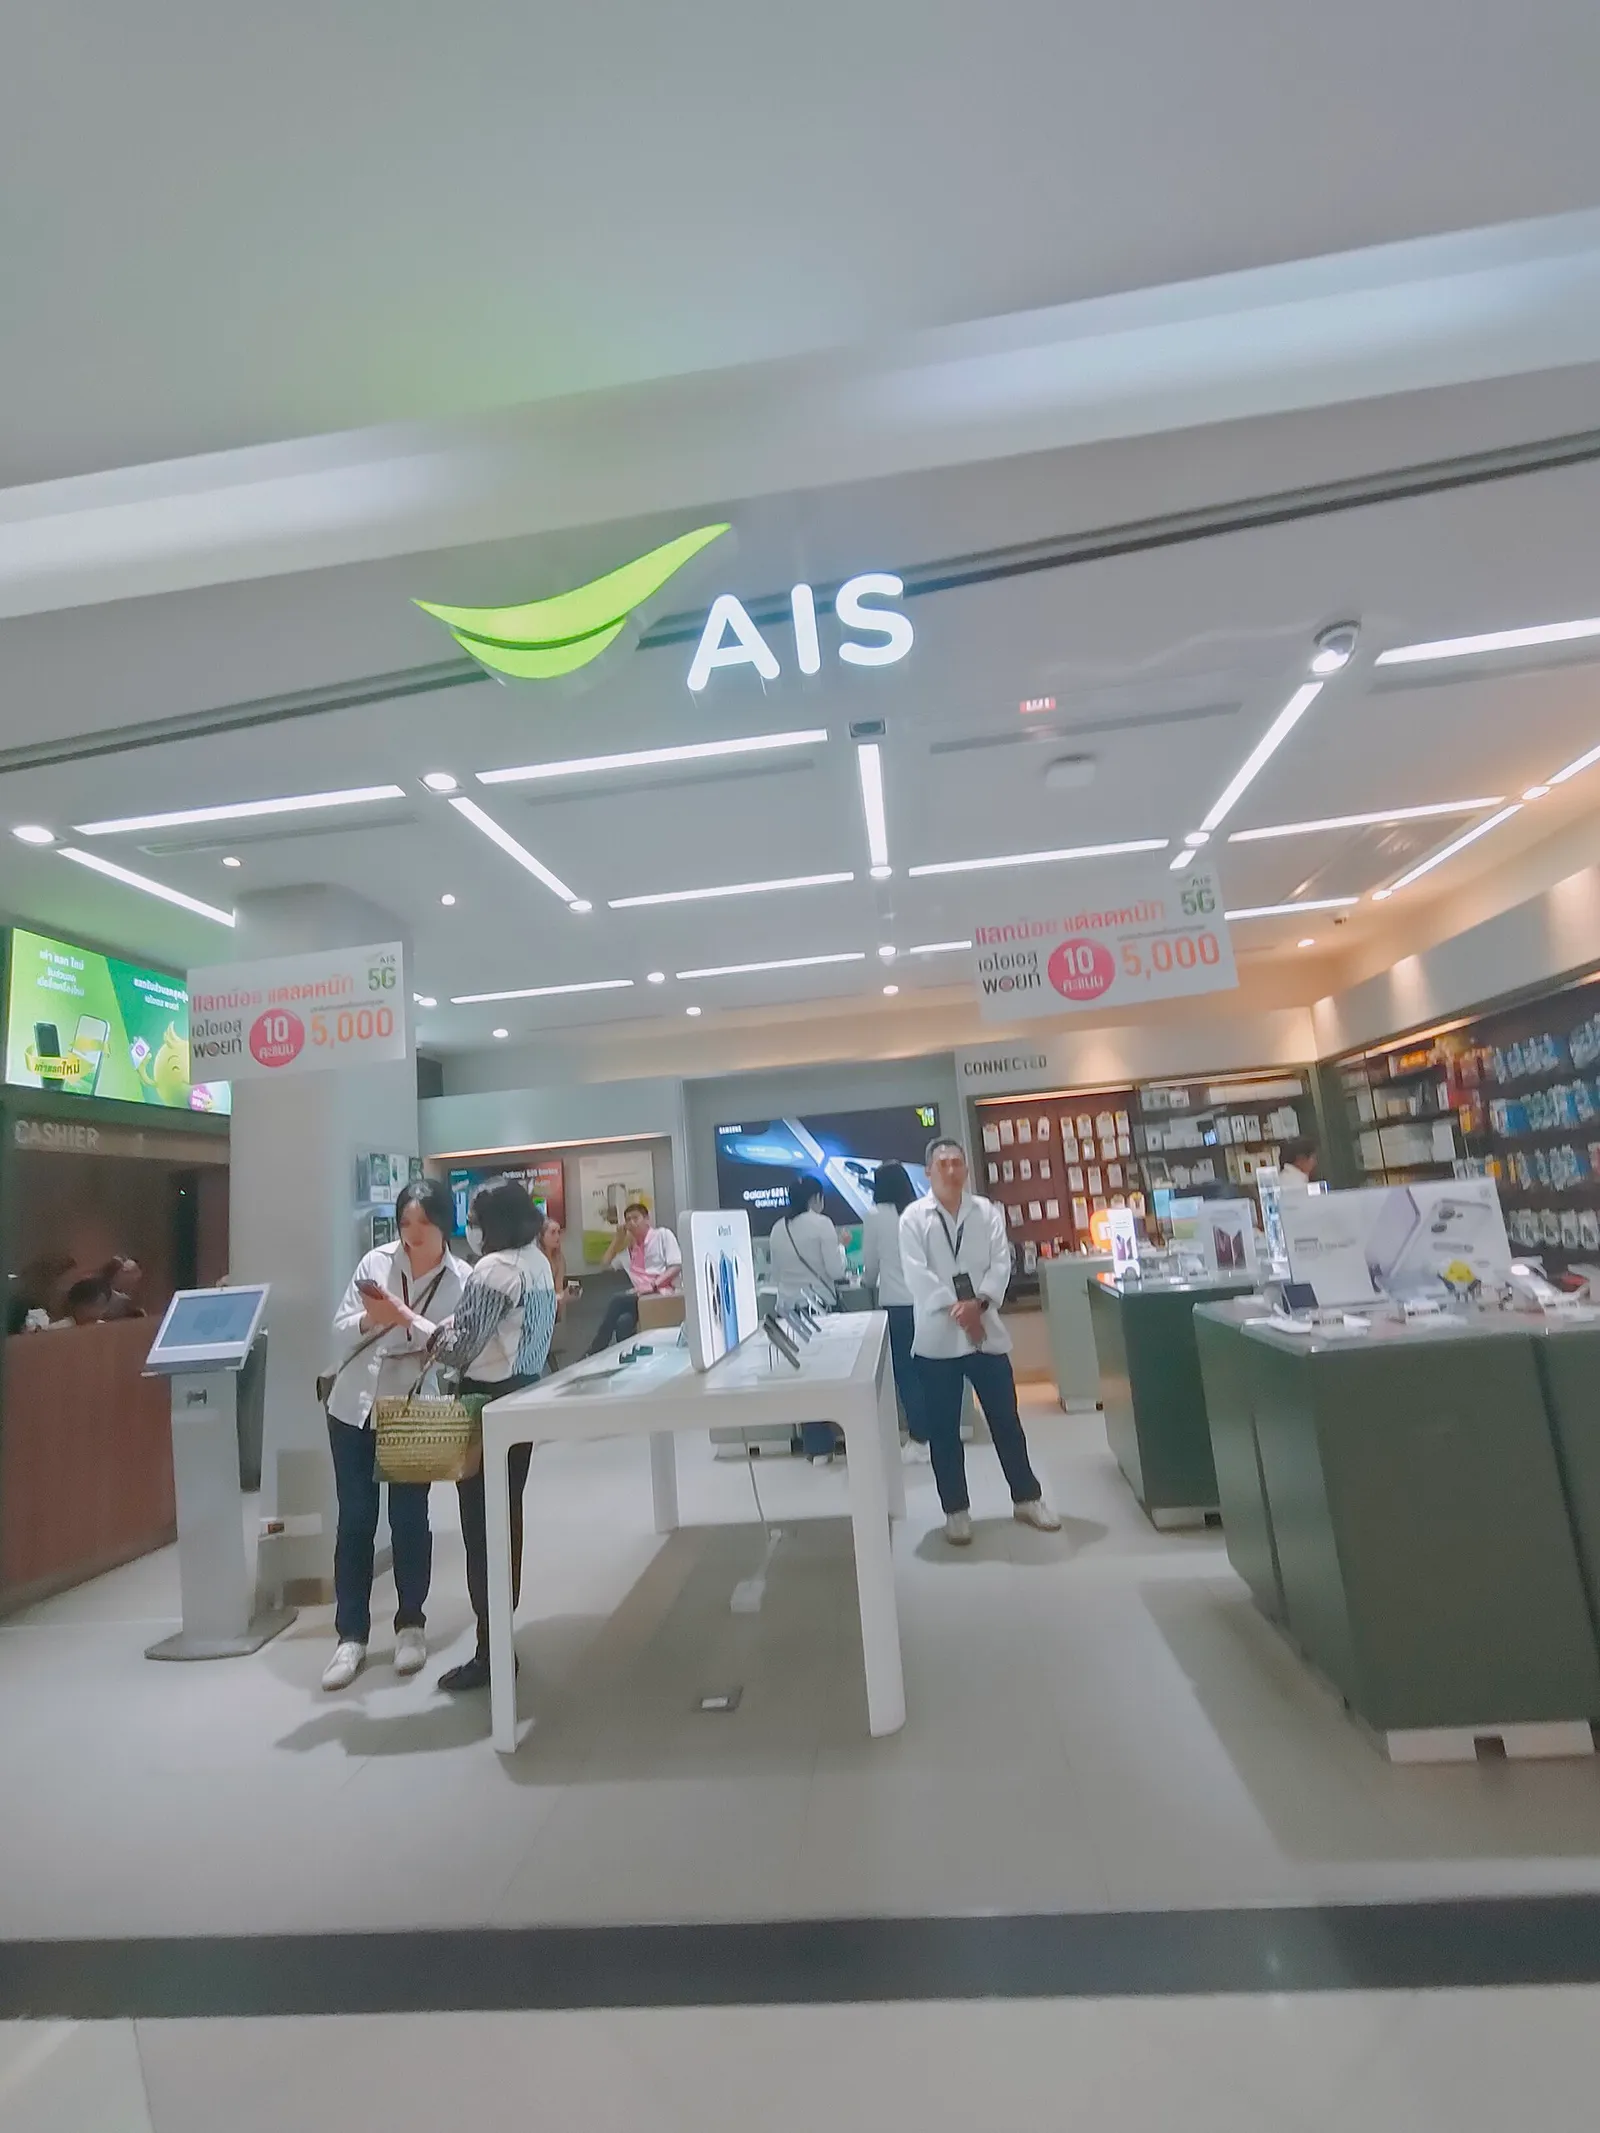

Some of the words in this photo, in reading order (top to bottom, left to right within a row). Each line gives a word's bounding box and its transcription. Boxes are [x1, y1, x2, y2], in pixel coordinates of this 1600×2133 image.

[686, 572, 914, 692] AIS
[1181, 888, 1215, 915] 5G
[380, 954, 396, 965] AIS
[1062, 945, 1095, 977] 10
[1120, 932, 1221, 980] 5,000
[368, 967, 396, 990] 5G
[263, 1015, 289, 1044] 10
[310, 1006, 394, 1049] 5,000
[963, 1054, 1047, 1077] CONNECTED
[14, 1119, 100, 1149] CASHIER
[743, 1189, 770, 1201] Galaxy
[755, 1198, 777, 1208] Galaxy
